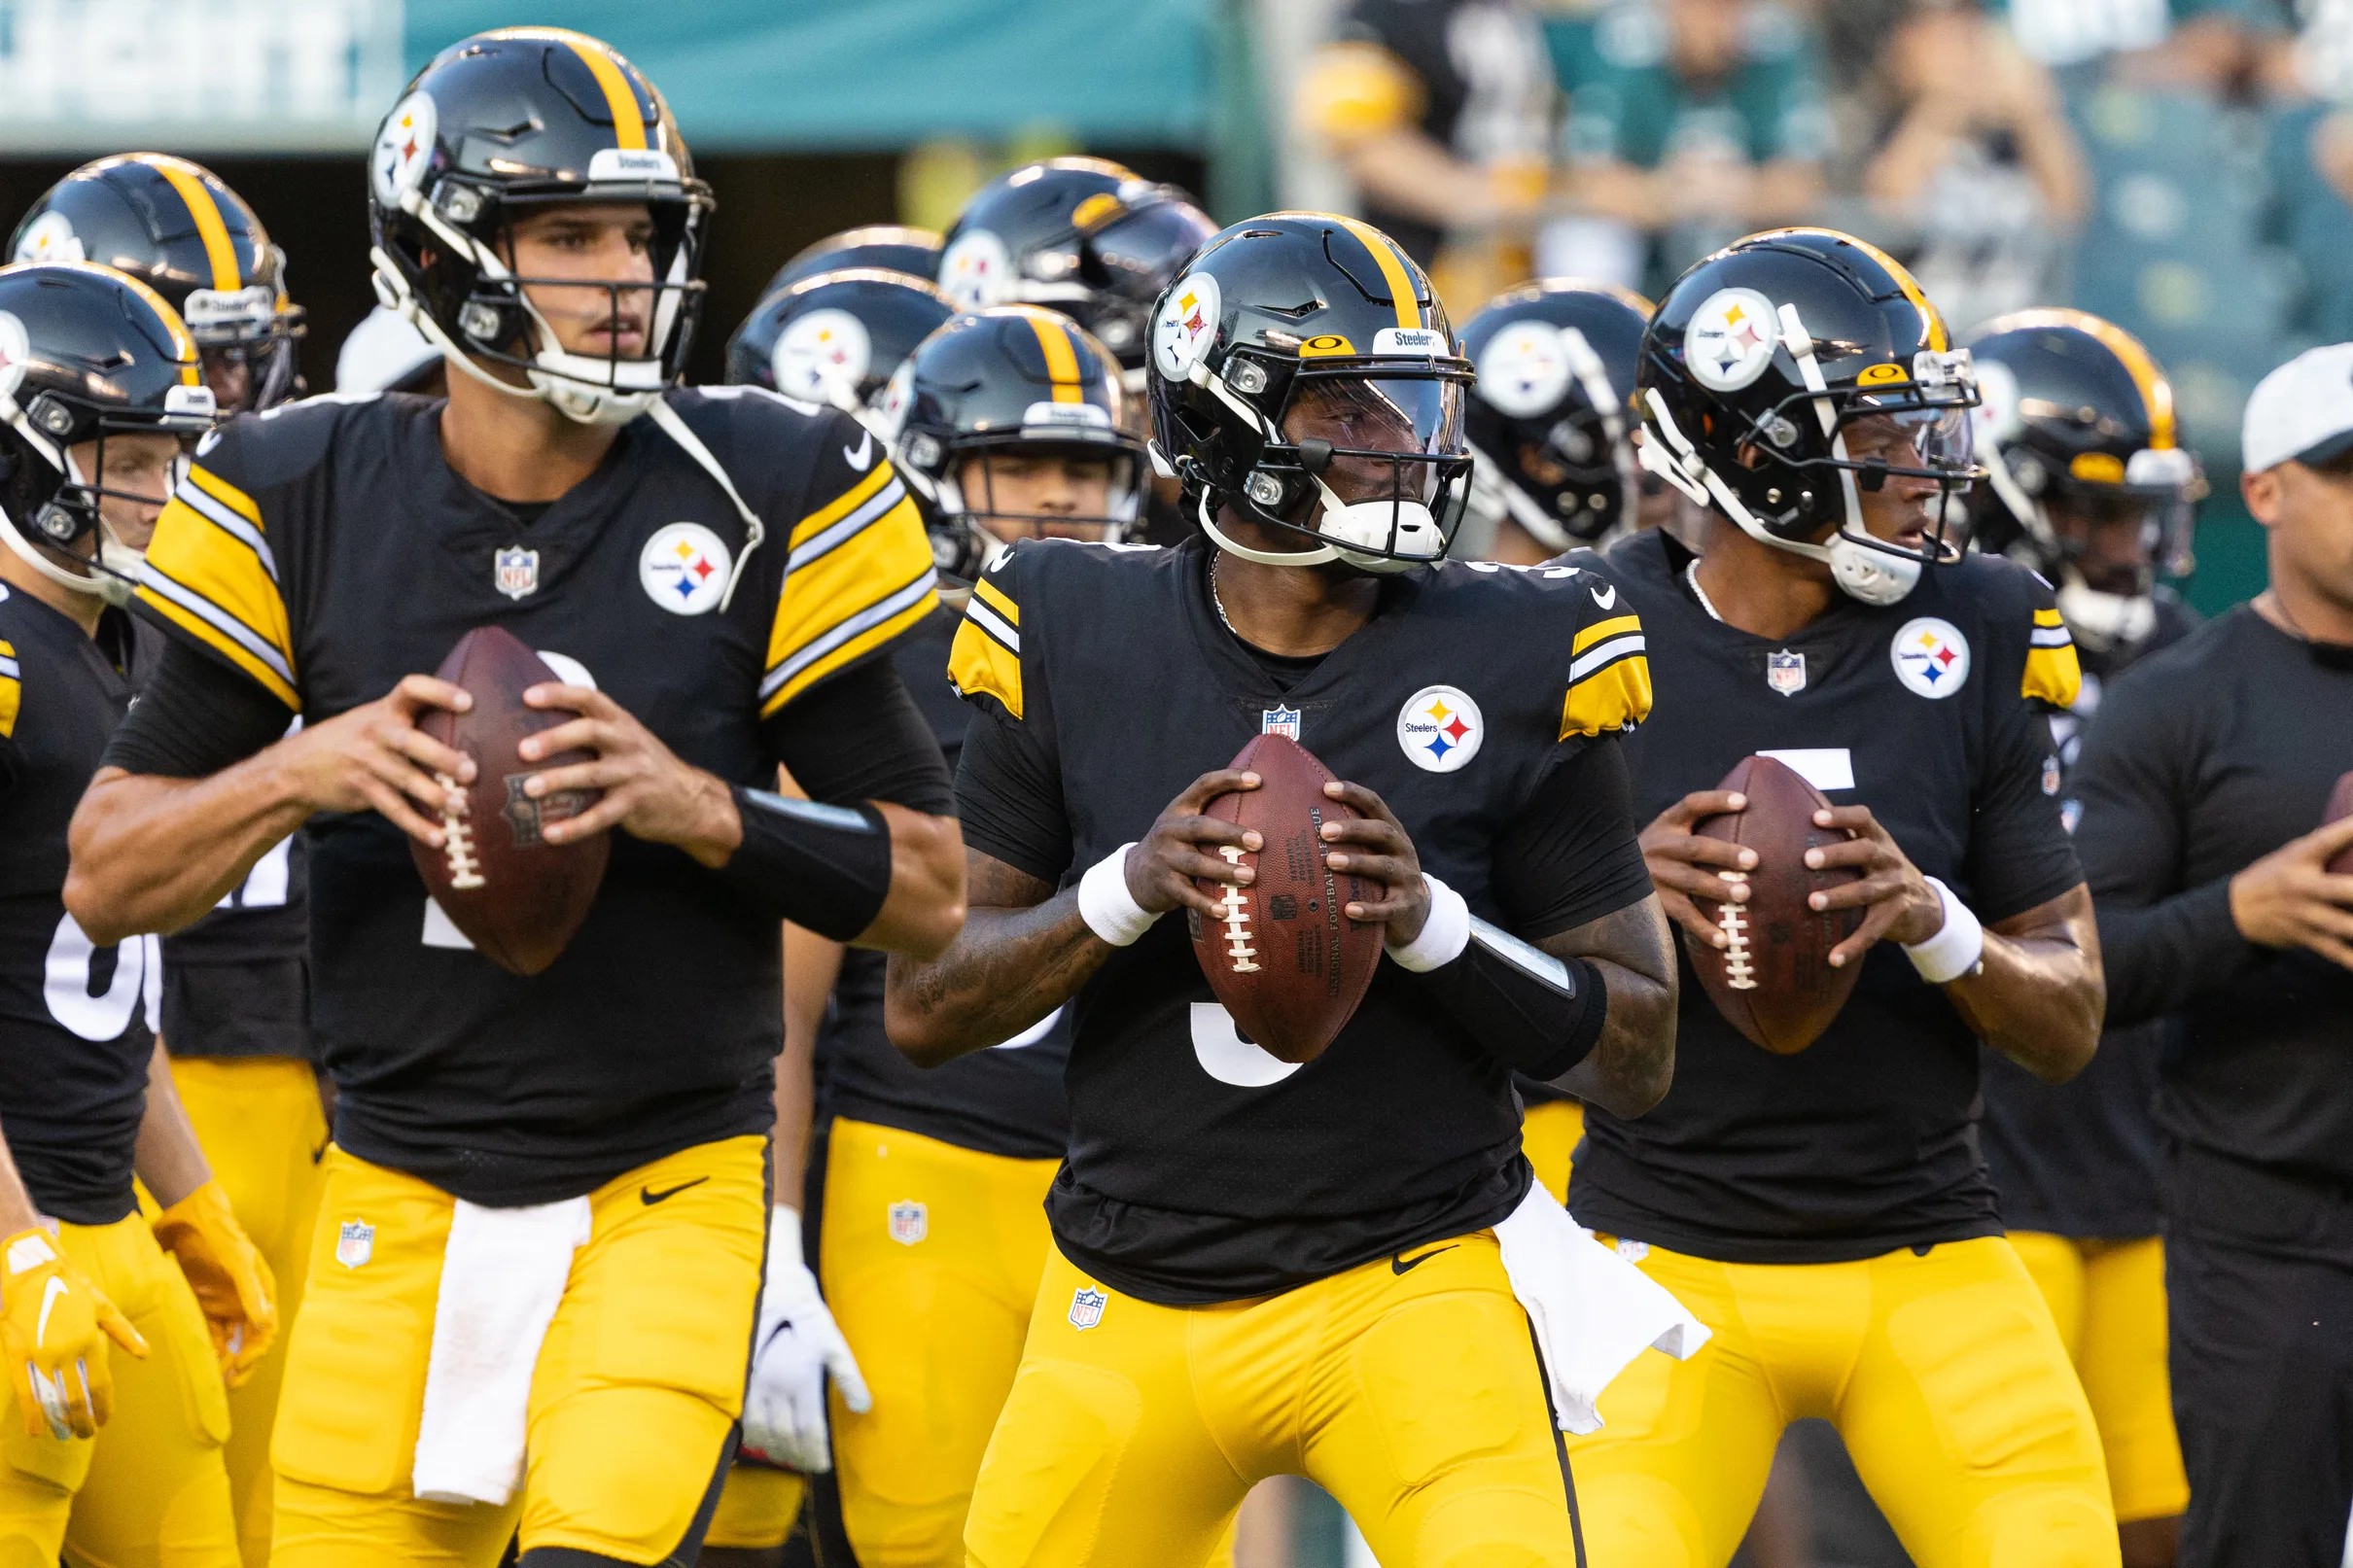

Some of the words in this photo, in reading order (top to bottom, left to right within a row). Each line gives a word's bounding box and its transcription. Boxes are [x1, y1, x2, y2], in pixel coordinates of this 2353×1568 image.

[1405, 722, 1438, 734] Steelers
[1310, 808, 1328, 857] LEGUE
[1323, 865, 1338, 930] FOOTBAL
[1328, 935, 1341, 996] NATIONAL
[1072, 1305, 1097, 1323] NFL
